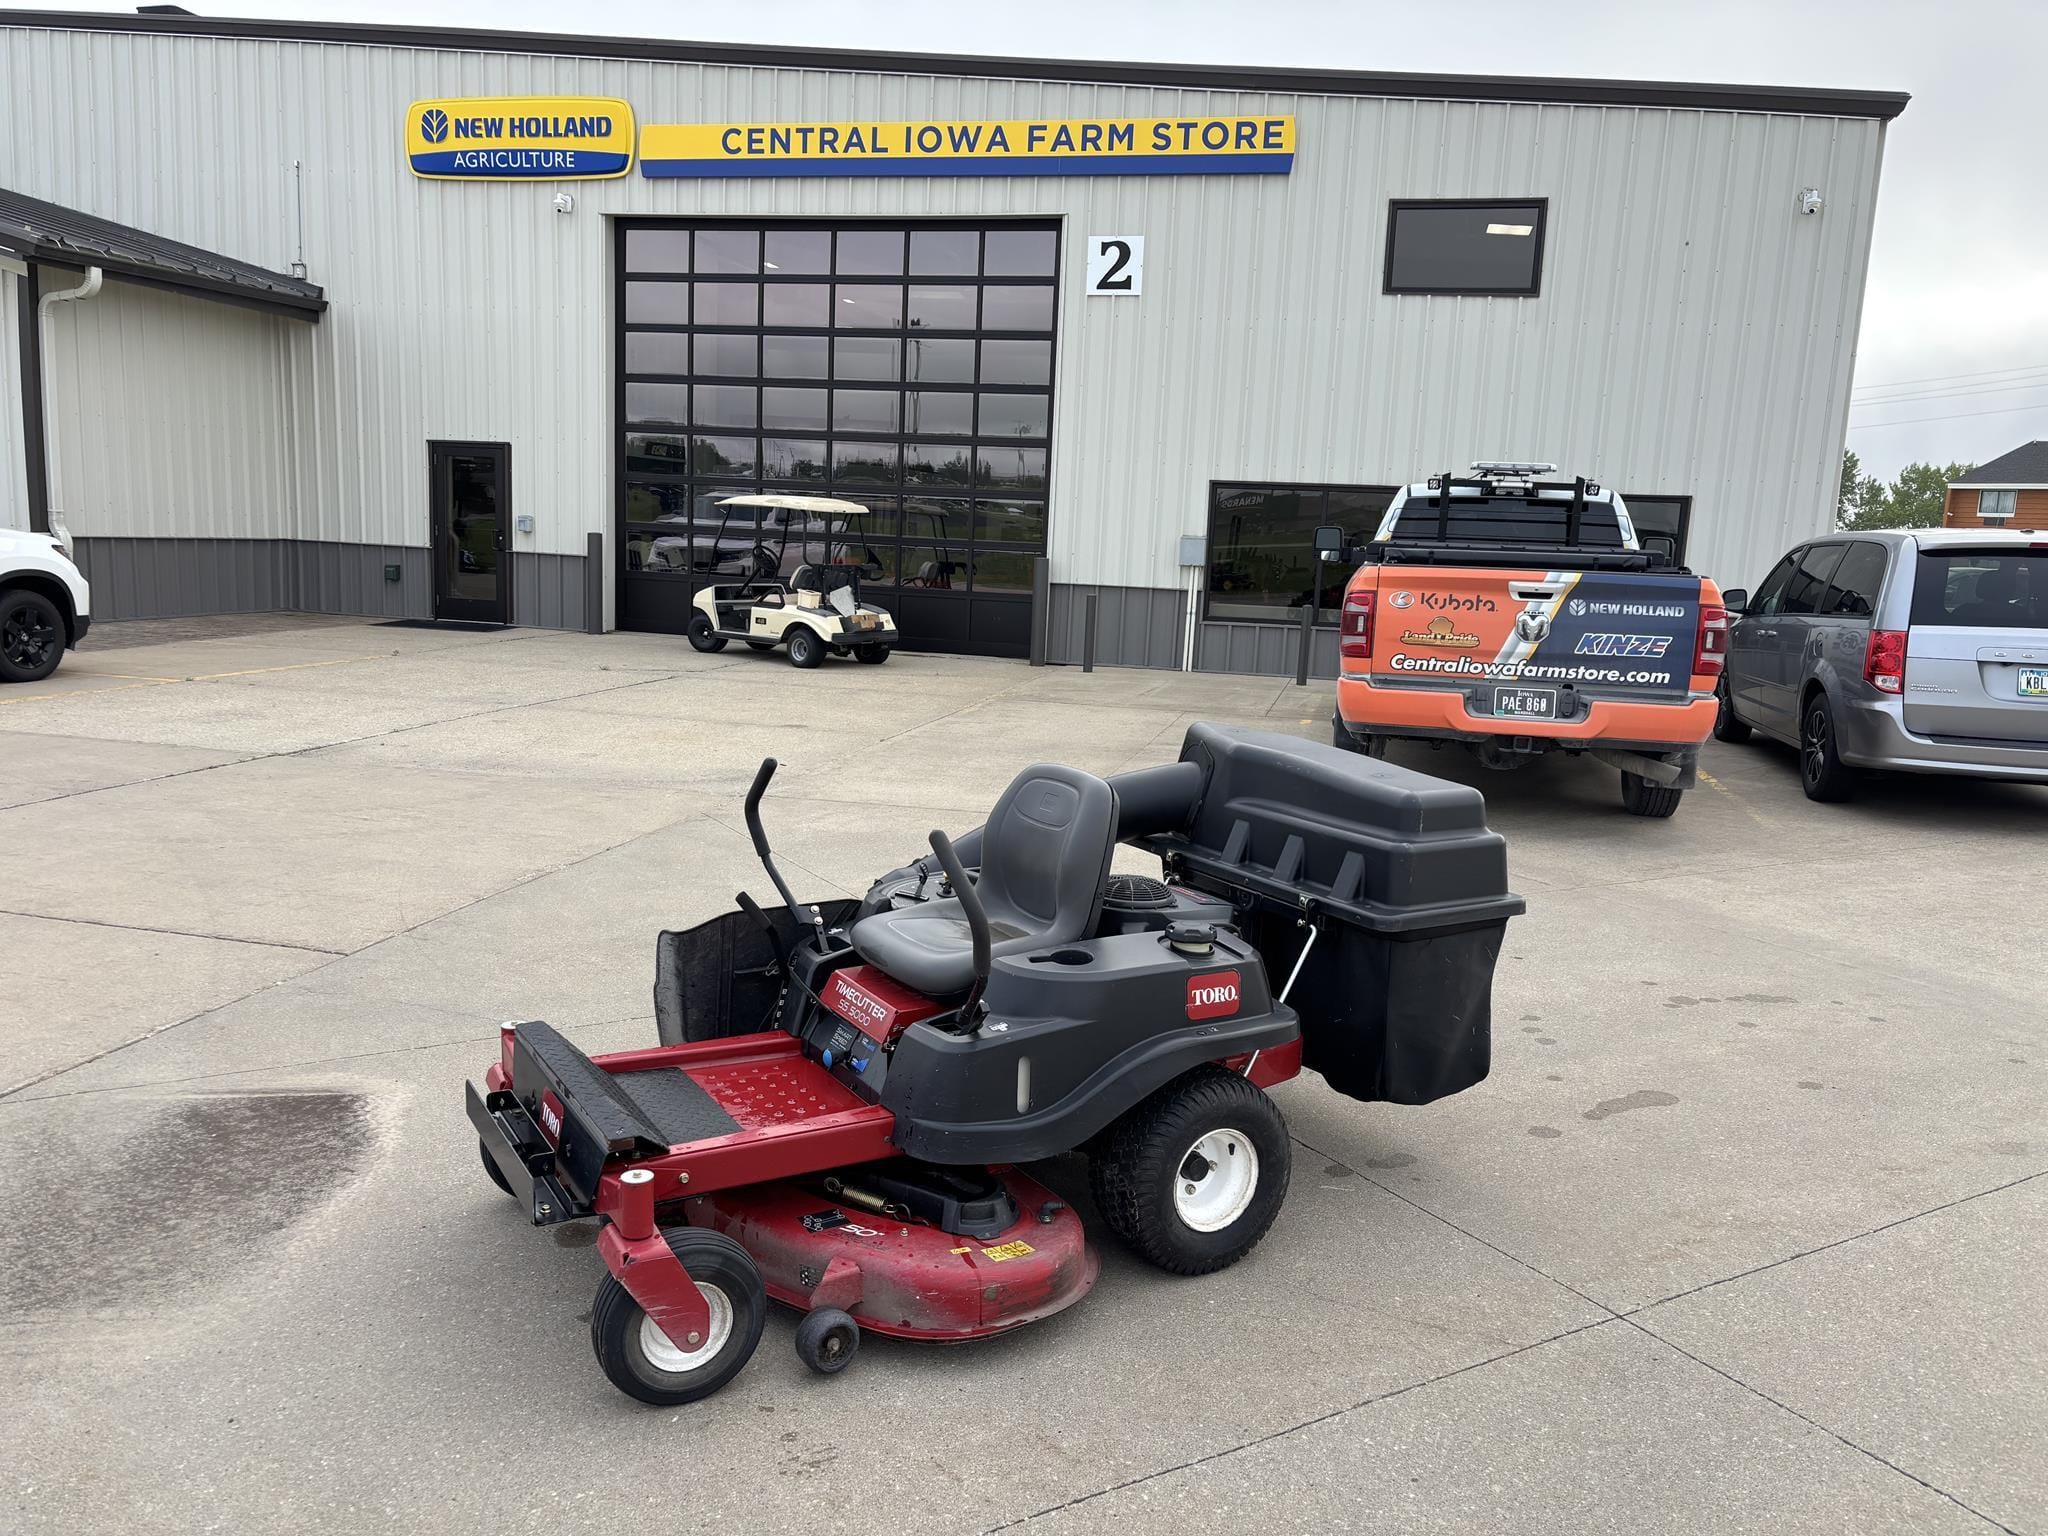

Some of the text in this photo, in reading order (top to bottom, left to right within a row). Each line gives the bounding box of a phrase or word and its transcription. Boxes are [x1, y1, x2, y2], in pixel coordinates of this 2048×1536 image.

[454, 115, 612, 138] NEW HOLLAND
[721, 120, 1285, 155] CENTRAL IOWA FARM STORE
[454, 151, 575, 168] AGRICULTURE
[1096, 240, 1133, 291] 2
[1589, 602, 1685, 618] NEW HOLLAND
[1574, 632, 1673, 658] KINZE
[1390, 653, 1671, 684] Centraliowafarmstore.com
[1502, 696, 1547, 712] PAE 860
[835, 979, 887, 1021] TIMECUTTER
[838, 998, 871, 1026] SS 5000
